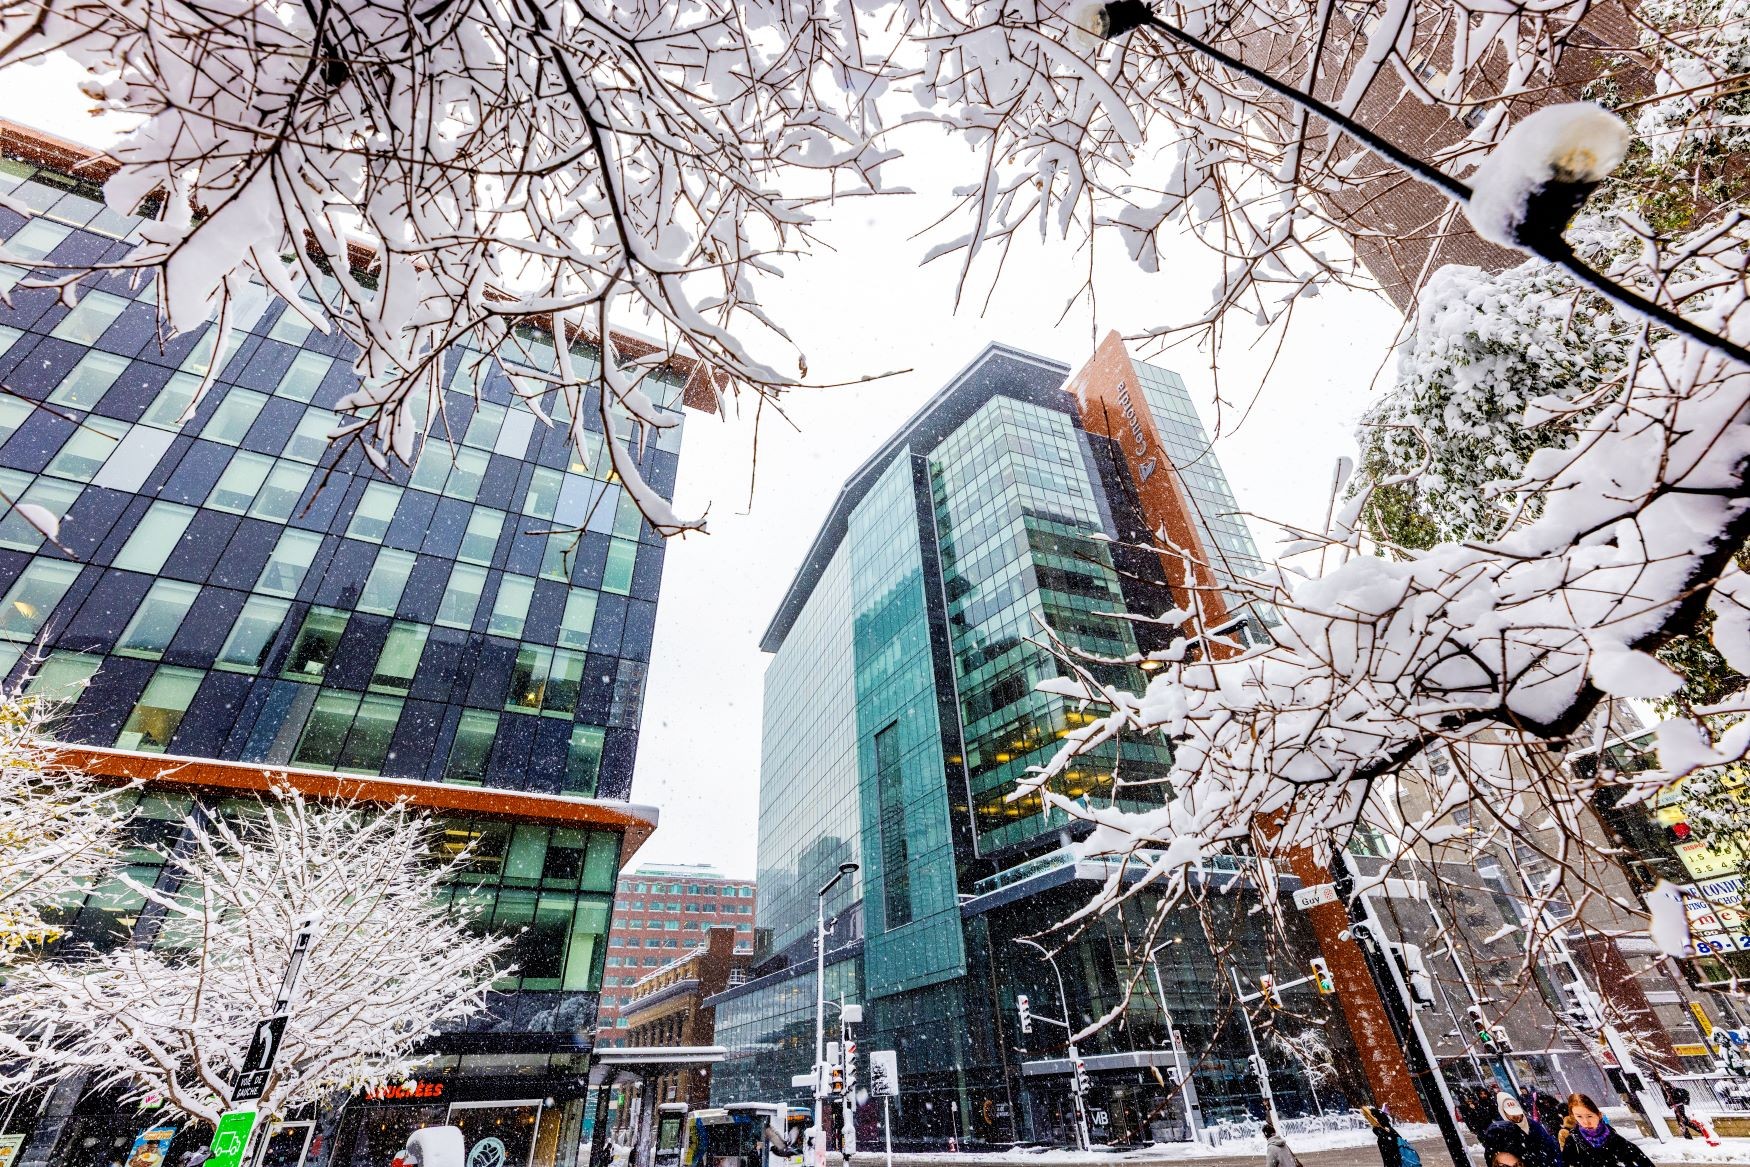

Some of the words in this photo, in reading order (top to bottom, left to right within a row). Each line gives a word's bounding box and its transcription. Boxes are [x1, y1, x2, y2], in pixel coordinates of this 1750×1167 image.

[1117, 380, 1147, 457] Concordia
[1682, 842, 1707, 852] DISPO
[1301, 896, 1320, 906] Guy
